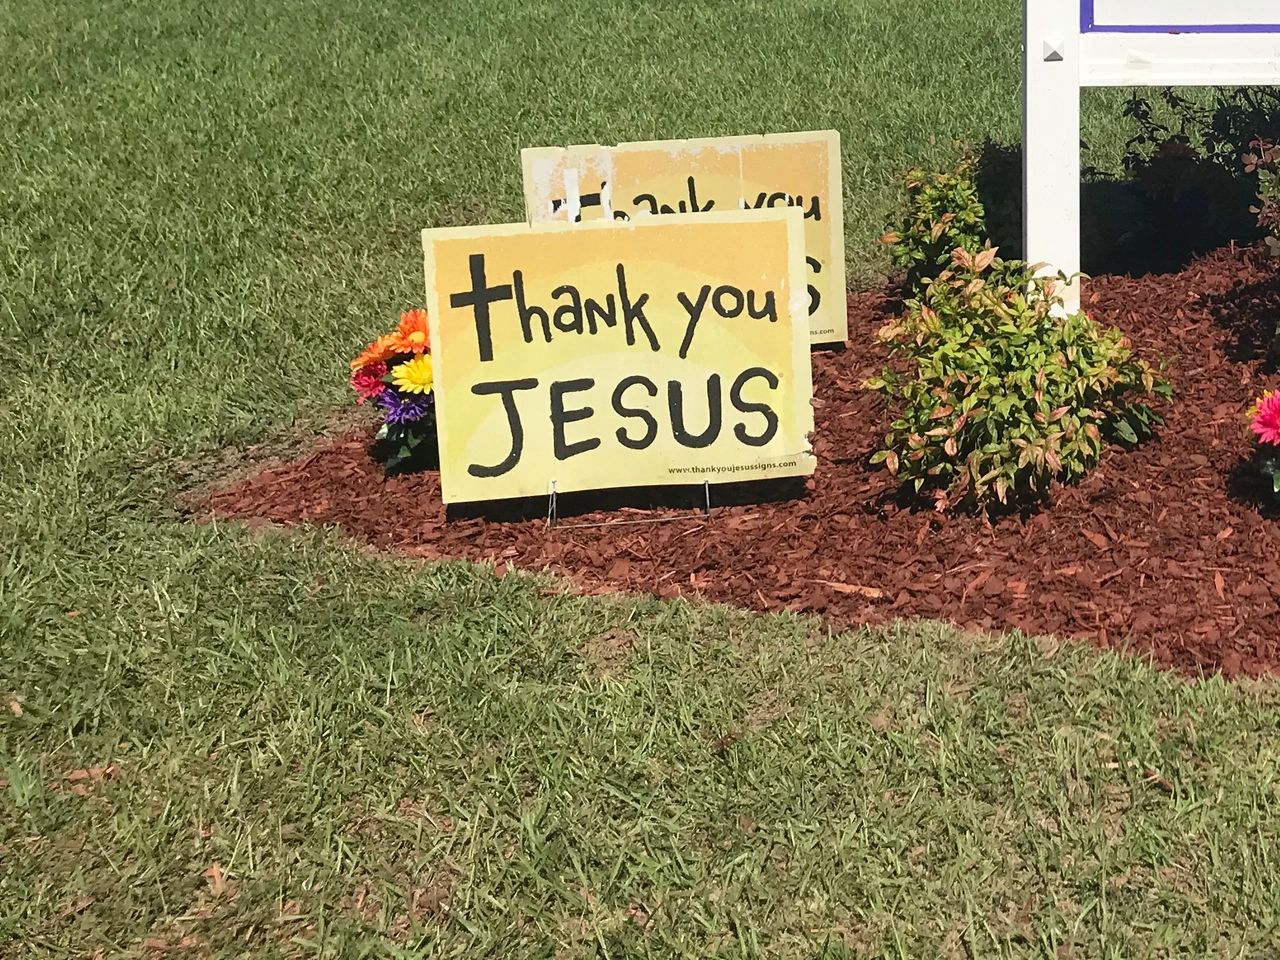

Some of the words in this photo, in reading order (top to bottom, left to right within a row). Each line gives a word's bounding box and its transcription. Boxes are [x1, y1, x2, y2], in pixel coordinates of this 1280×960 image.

[450, 253, 661, 363] thank
[677, 285, 778, 360] you
[467, 367, 780, 478] JESUS
[667, 459, 798, 475] www.thankyoujesussigns.com
